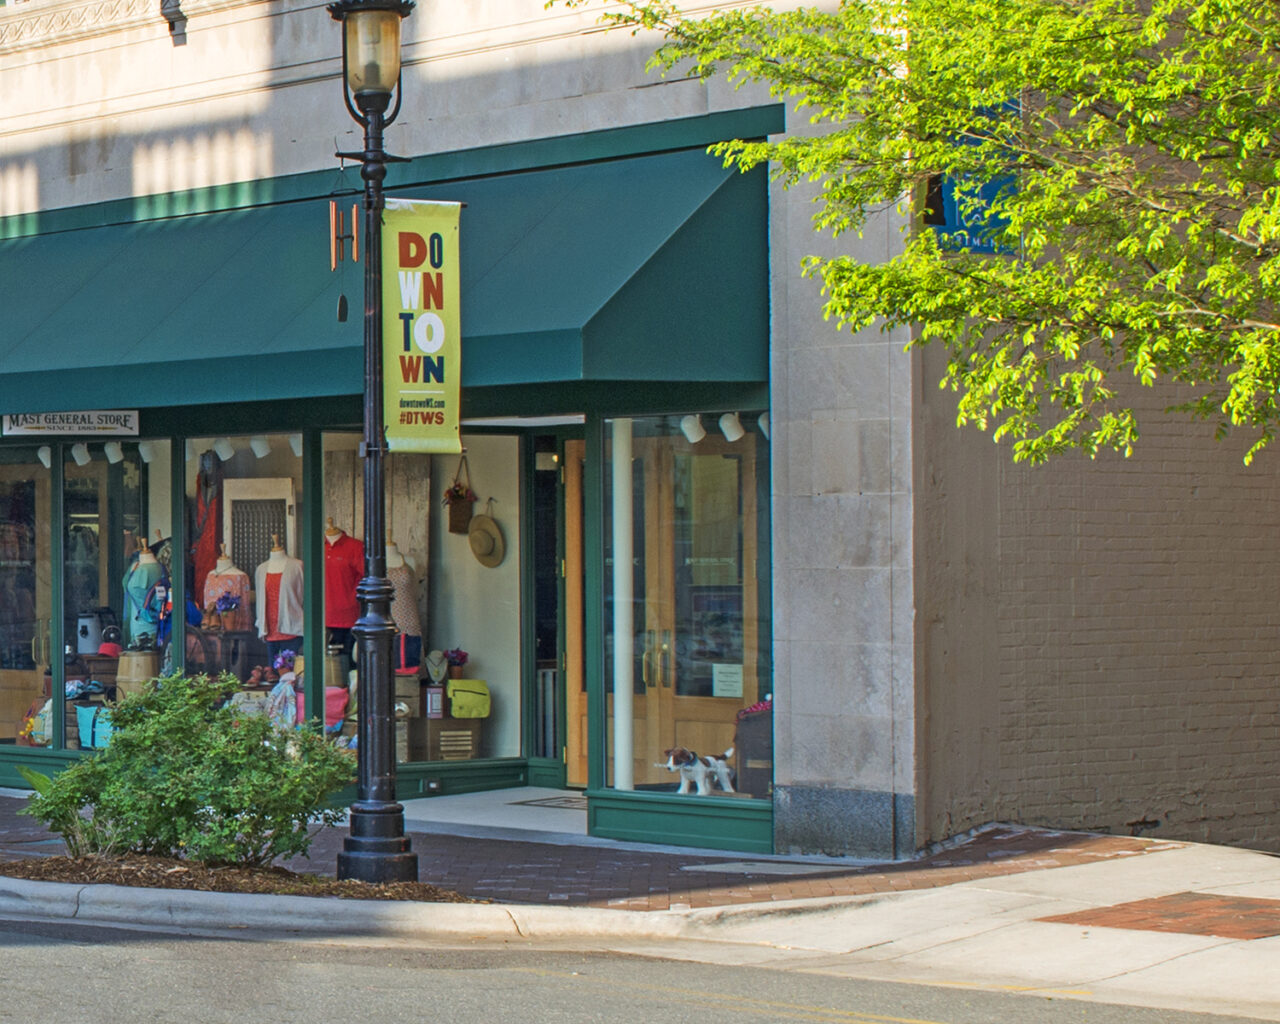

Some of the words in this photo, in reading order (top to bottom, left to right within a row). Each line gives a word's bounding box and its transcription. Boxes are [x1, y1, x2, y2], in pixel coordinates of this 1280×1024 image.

[8, 414, 41, 431] MAST
[44, 414, 94, 425] GENERAL
[97, 414, 134, 431] STORE
[399, 411, 445, 425] #DTWS
